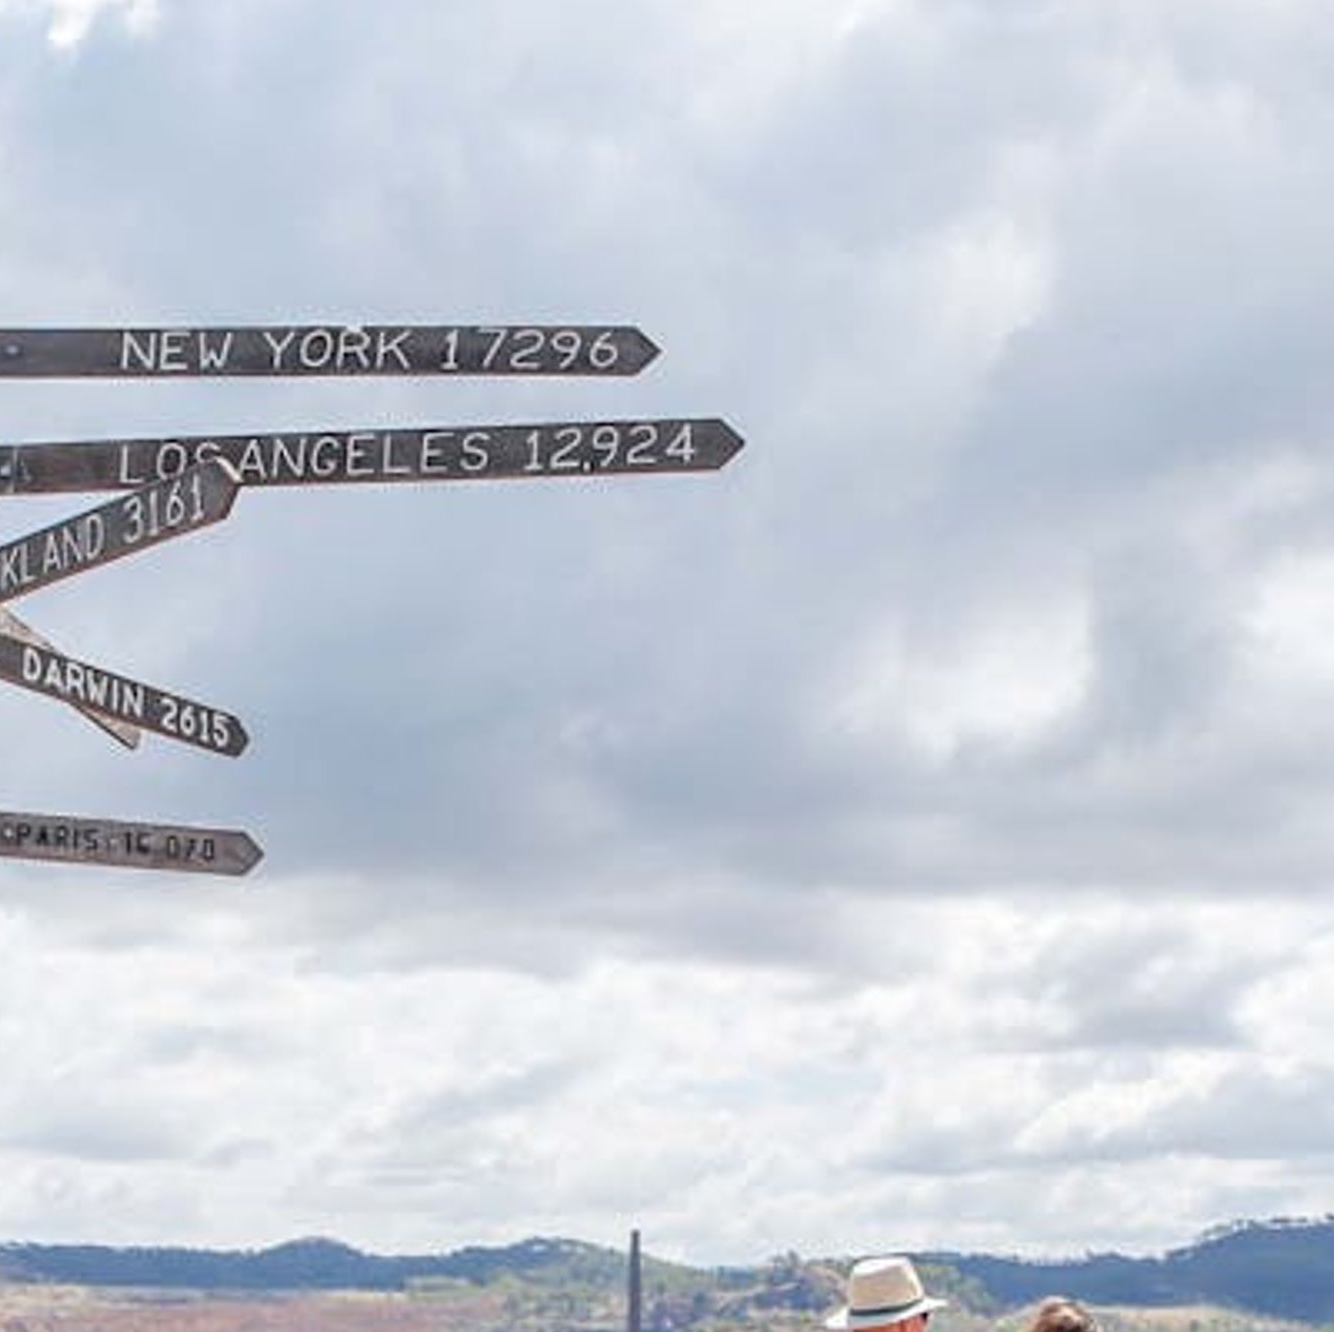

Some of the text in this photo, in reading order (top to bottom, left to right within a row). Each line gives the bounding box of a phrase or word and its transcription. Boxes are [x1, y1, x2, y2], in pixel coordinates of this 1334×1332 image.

[120, 327, 617, 370] NEW YORK 17296
[239, 431, 491, 478] ANGELES
[123, 473, 205, 545] 3161
[22, 648, 230, 748] DARWIN 2615
[16, 823, 98, 852] PARIS
